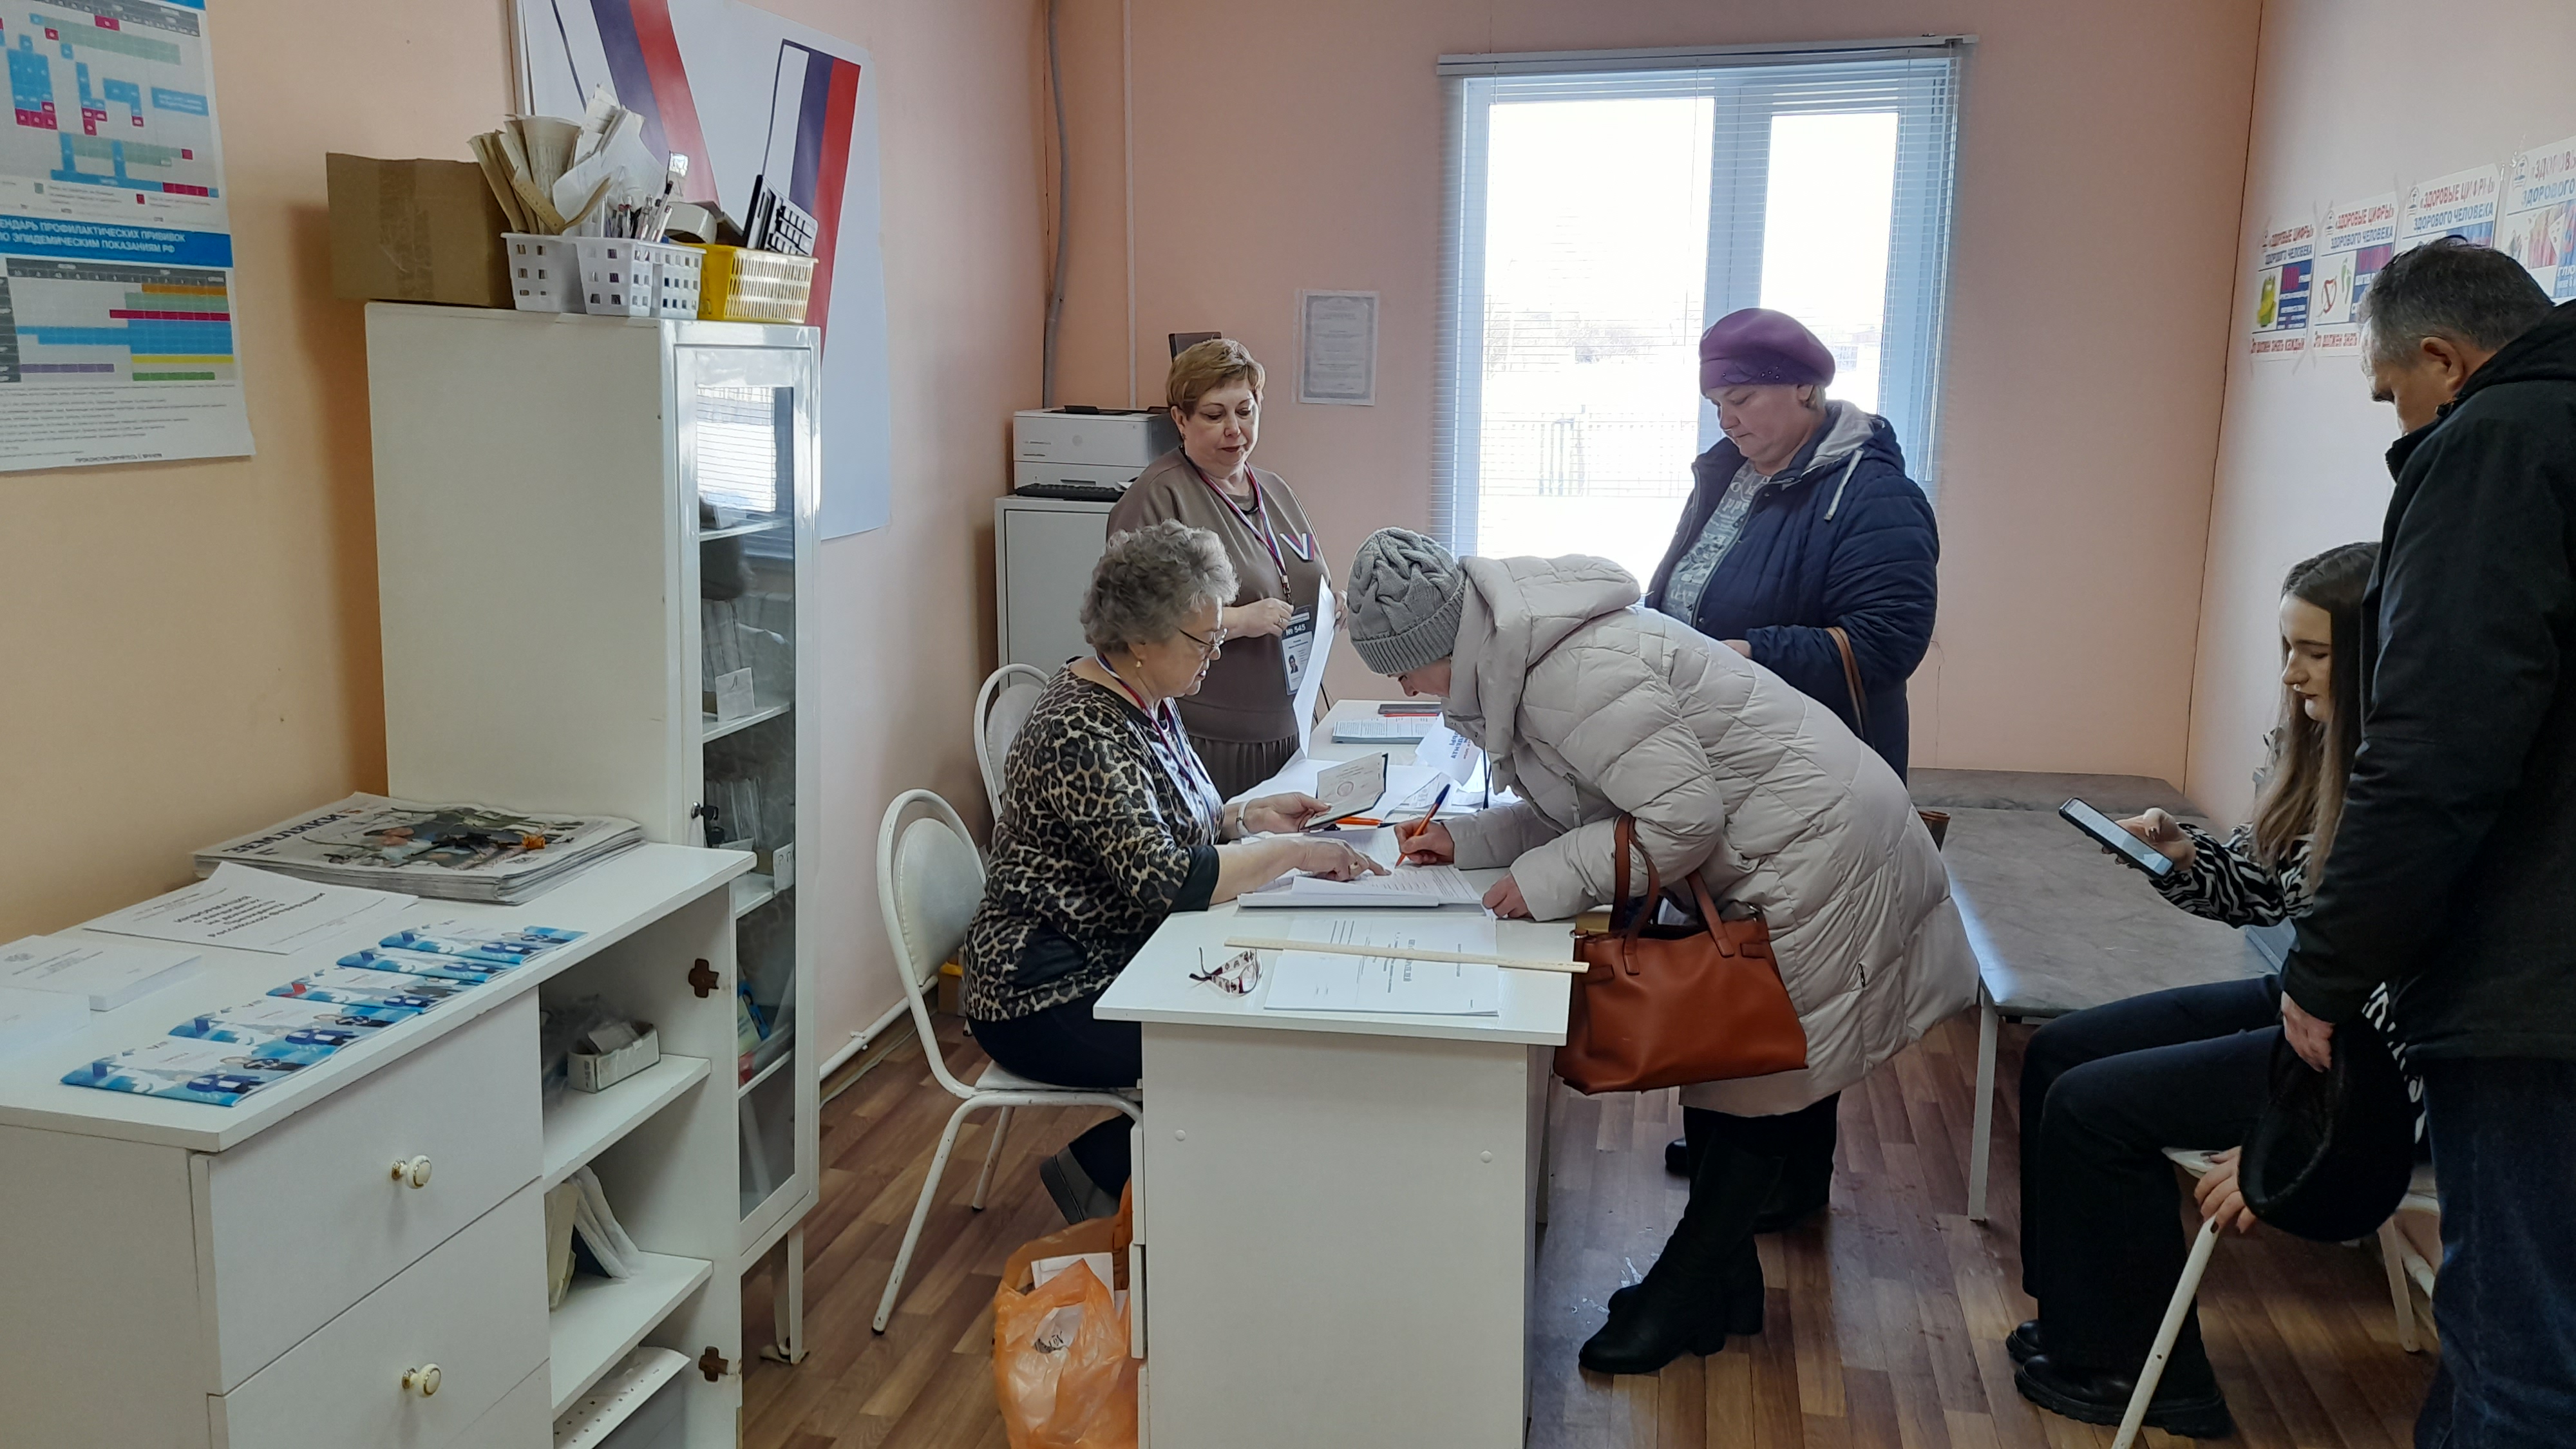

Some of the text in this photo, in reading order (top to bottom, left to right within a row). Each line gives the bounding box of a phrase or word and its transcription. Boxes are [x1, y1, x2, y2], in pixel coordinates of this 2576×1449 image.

[2521, 178, 2575, 207] ЗДОРОВОГО
[2413, 201, 2494, 233] ЗДОРОВОГО ЧЕЛОВЕКА
[0, 219, 39, 231] ЕНДАРЬ
[140, 230, 186, 243] ПРИВИВОК
[2362, 225, 2393, 243] ЧЕЛОВЕКА
[162, 243, 176, 254] РФ
[1294, 623, 1306, 634] 545
[222, 813, 349, 854] ЗЕМЛЯКИ
